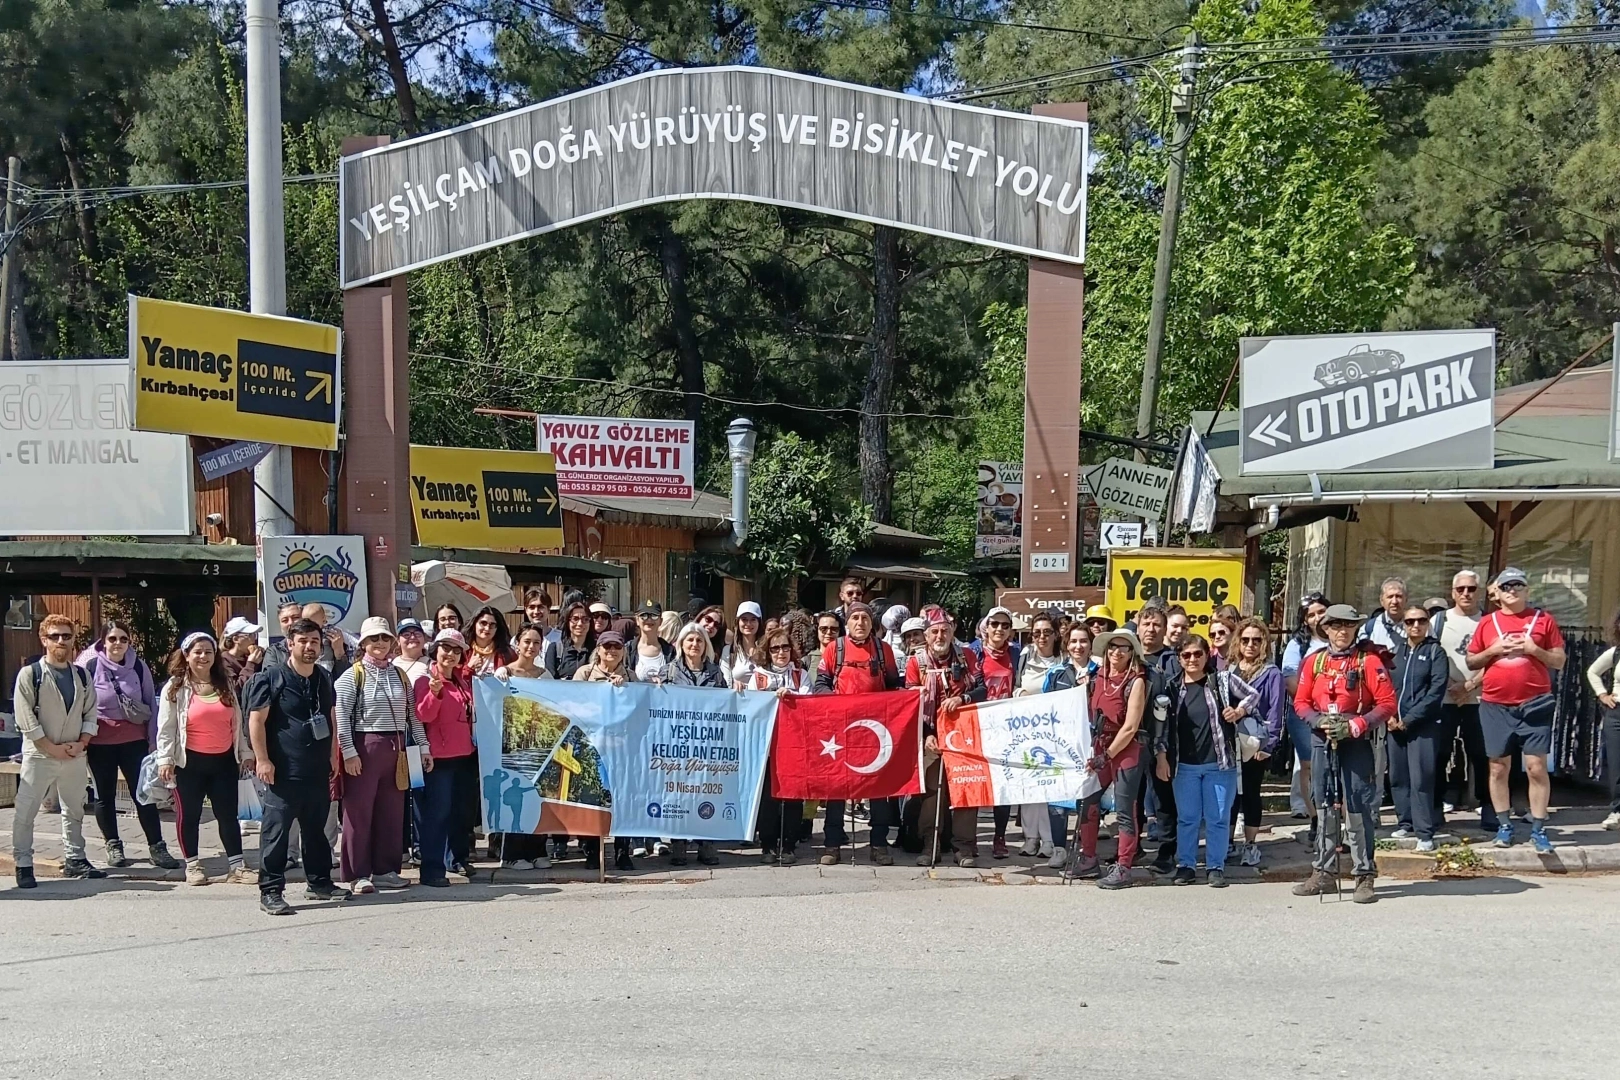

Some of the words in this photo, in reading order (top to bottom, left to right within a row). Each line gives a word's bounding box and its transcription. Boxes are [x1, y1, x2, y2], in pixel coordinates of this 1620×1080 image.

[350, 155, 503, 242] YEŞİLÇAM
[508, 125, 602, 178] DOĞA
[607, 105, 767, 153] YÜRÜYÜŞ
[777, 113, 819, 146] VE
[829, 112, 987, 178] BİSİKLET
[994, 155, 1082, 215] YOLU
[141, 336, 232, 383] Yamaç
[241, 361, 268, 379] 100
[273, 366, 296, 382] Mt.
[141, 377, 234, 402] Kırbahçesi
[542, 422, 600, 440] YAVUZ
[606, 422, 690, 444] GÖZLEME
[17, 440, 42, 465] ET
[47, 439, 139, 465] MANGAL
[217, 453, 234, 468] MT.
[231, 442, 263, 463] İÇERİDE
[550, 442, 680, 470] KAHVALTI
[556, 472, 568, 480] ZEL
[603, 474, 655, 483] ORGANİZASYON
[654, 476, 680, 484] YAPILIR
[1108, 464, 1168, 490] ANNEM
[411, 475, 478, 508] Yamaç
[487, 487, 510, 502] 100
[512, 488, 532, 503] Mt.
[557, 482, 570, 491] Tel:
[571, 483, 590, 491] 0535
[591, 483, 606, 491] 829
[606, 484, 617, 492] 95
[618, 485, 628, 493] 03
[633, 486, 652, 494] 0536
[652, 486, 666, 494] 457
[667, 487, 678, 495] 45
[678, 487, 689, 495] 23
[1101, 486, 1162, 513] GÖZLEME
[421, 508, 481, 522] Kırbahçesi
[1034, 557, 1065, 568] 2021
[275, 573, 324, 592] GURME
[327, 573, 357, 591] KÖY
[1119, 569, 1229, 608] Yamaç
[1024, 598, 1086, 612] Yamaç
[648, 707, 674, 719] TURİZM
[675, 710, 703, 721] HAFTASI
[704, 711, 747, 724] KAPSAMINDA
[1005, 711, 1061, 731] TODOSK
[670, 722, 724, 743] YEŞİLÇAM
[710, 746, 740, 761] ETABI
[650, 757, 682, 775] Doğa
[685, 758, 740, 776] Yürüyüşü
[952, 763, 983, 773] ANTALYA
[665, 781, 674, 793] 19
[676, 781, 700, 794] Nisan
[702, 782, 723, 795] 2026
[951, 774, 988, 784] TÜRKİYE
[1037, 778, 1057, 787] 1991
